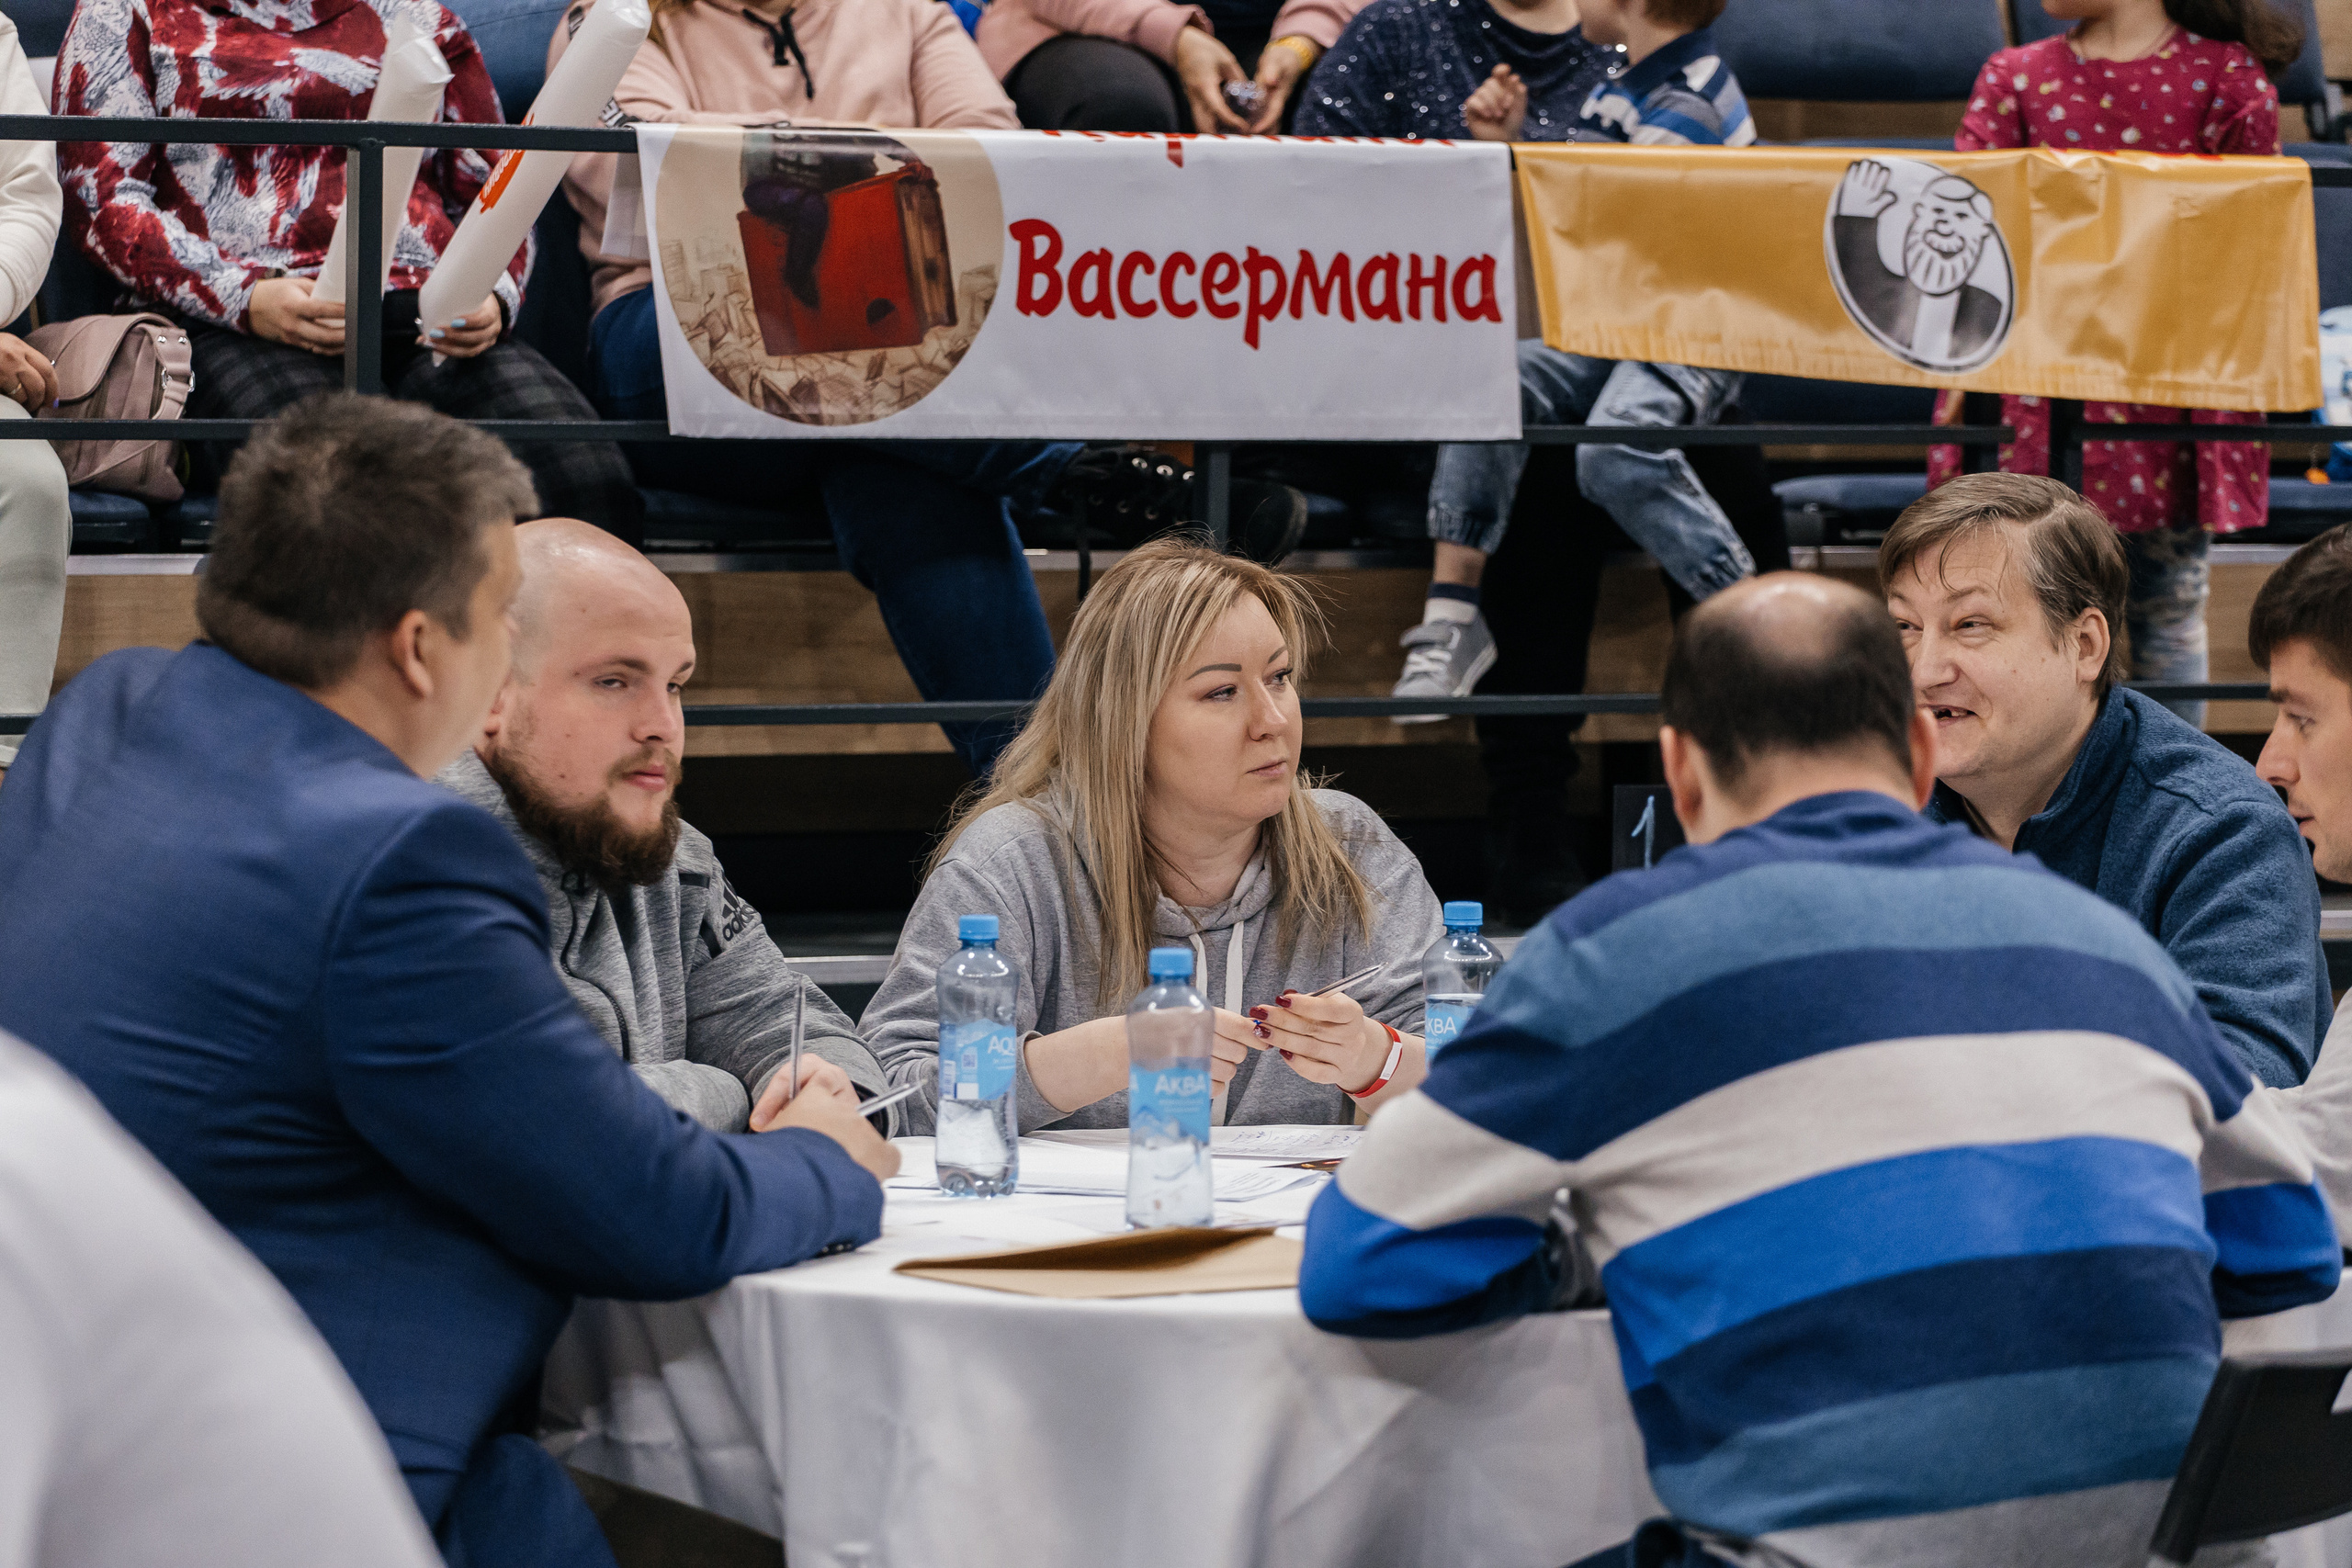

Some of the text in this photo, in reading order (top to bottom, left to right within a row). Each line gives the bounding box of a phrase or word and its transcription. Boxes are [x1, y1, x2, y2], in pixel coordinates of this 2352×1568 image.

[1009, 219, 1503, 351] Вассермана
[1631, 795, 1656, 870] 1
[723, 903, 759, 942] adida
[987, 1035, 1015, 1056] AQ
